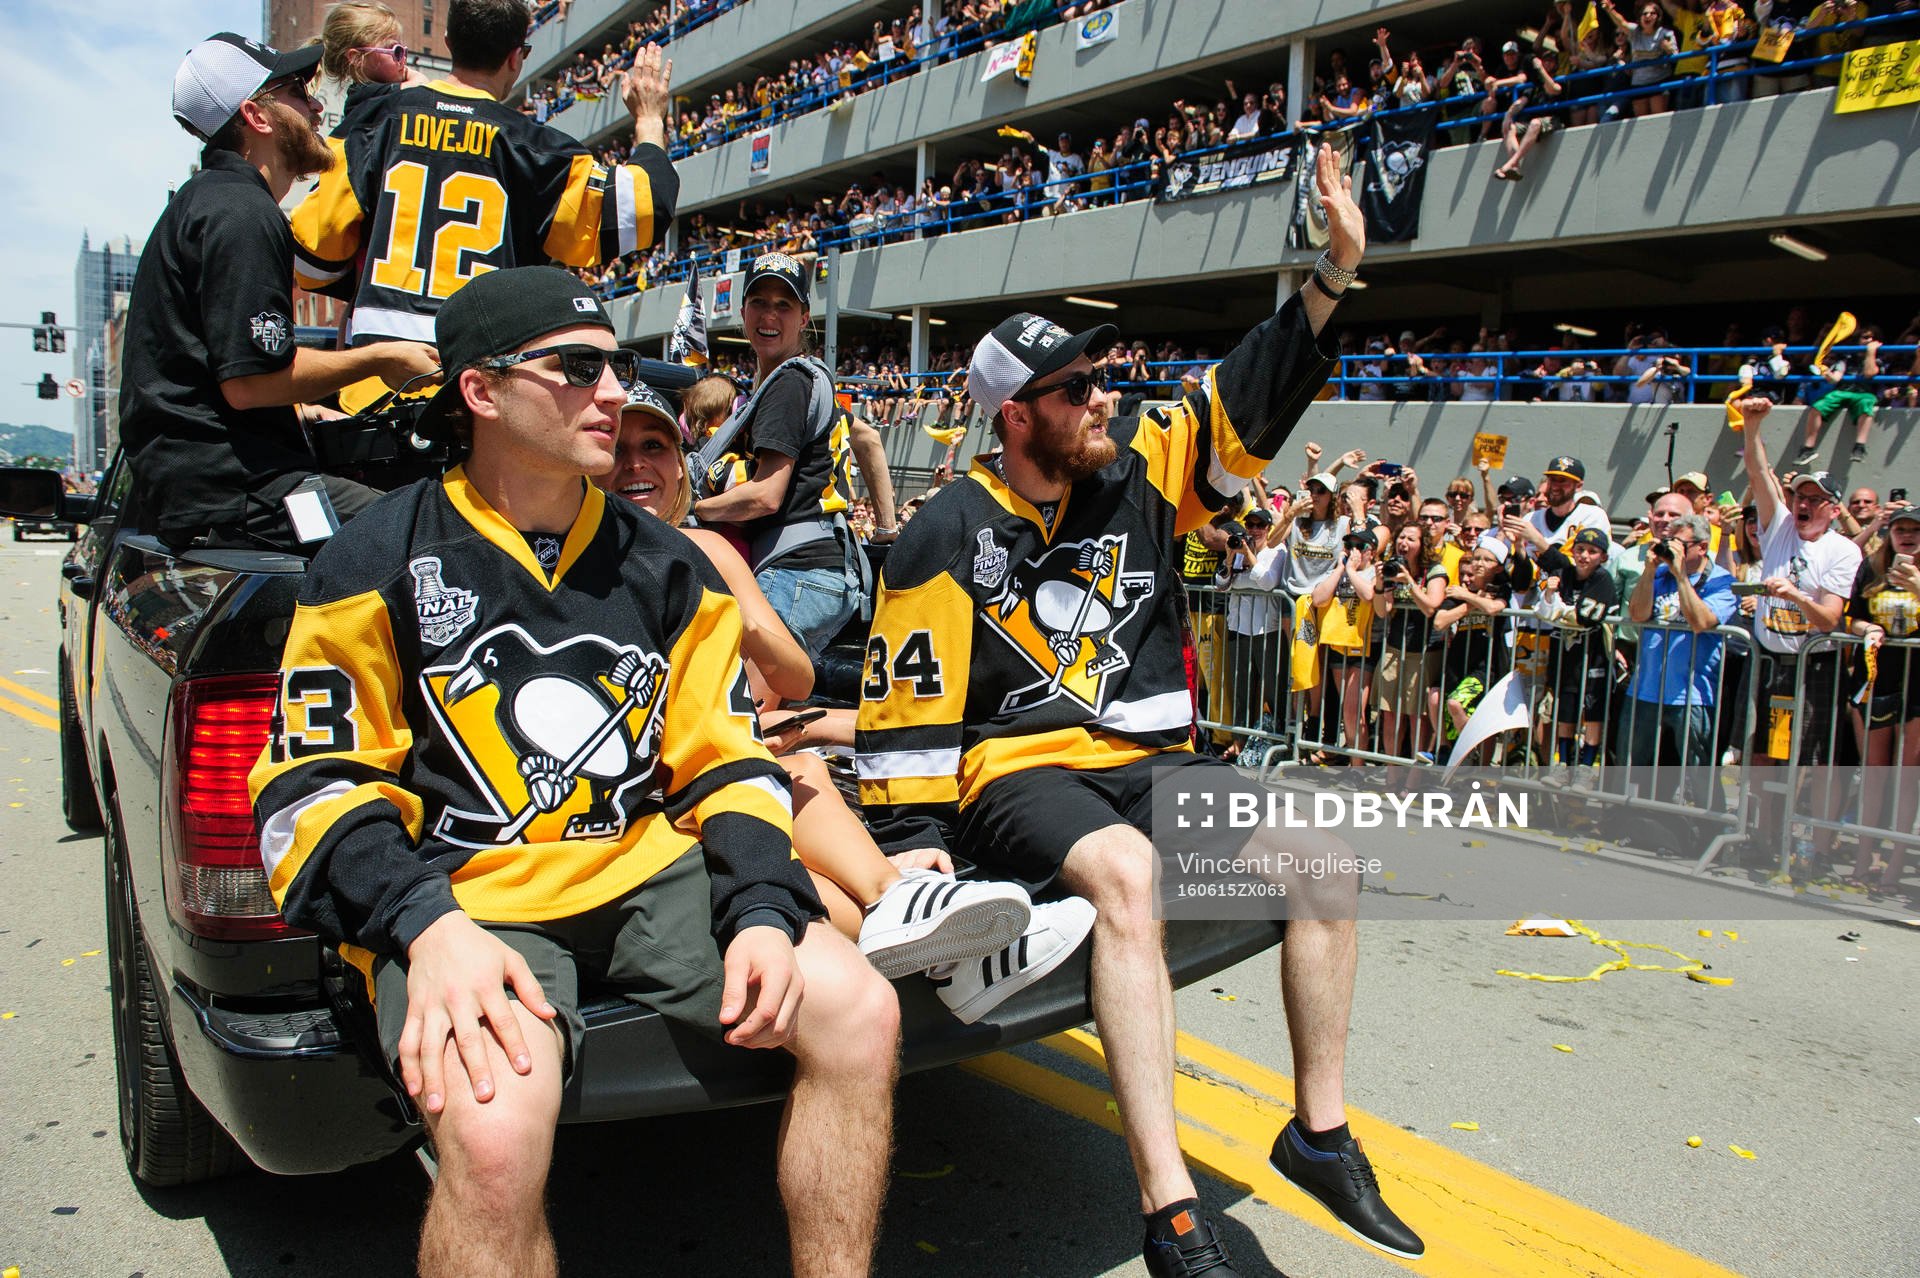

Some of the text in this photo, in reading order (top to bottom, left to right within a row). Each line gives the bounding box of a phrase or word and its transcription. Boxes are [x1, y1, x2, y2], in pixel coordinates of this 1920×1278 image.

[1847, 47, 1910, 68] KESSEL'S
[1845, 63, 1904, 83] WIENERS
[436, 101, 474, 115] Reebok
[400, 112, 500, 158] LOVEJOY
[1197, 147, 1292, 184] PENGUINS
[371, 160, 509, 300] 12
[251, 326, 286, 339] PENS
[262, 338, 279, 350] TV
[540, 546, 555, 561] NHL
[974, 552, 1006, 570] FINAL
[441, 592, 458, 600] CUP
[416, 597, 470, 617] INAL
[1579, 597, 1606, 620] 71
[862, 628, 945, 702] 34
